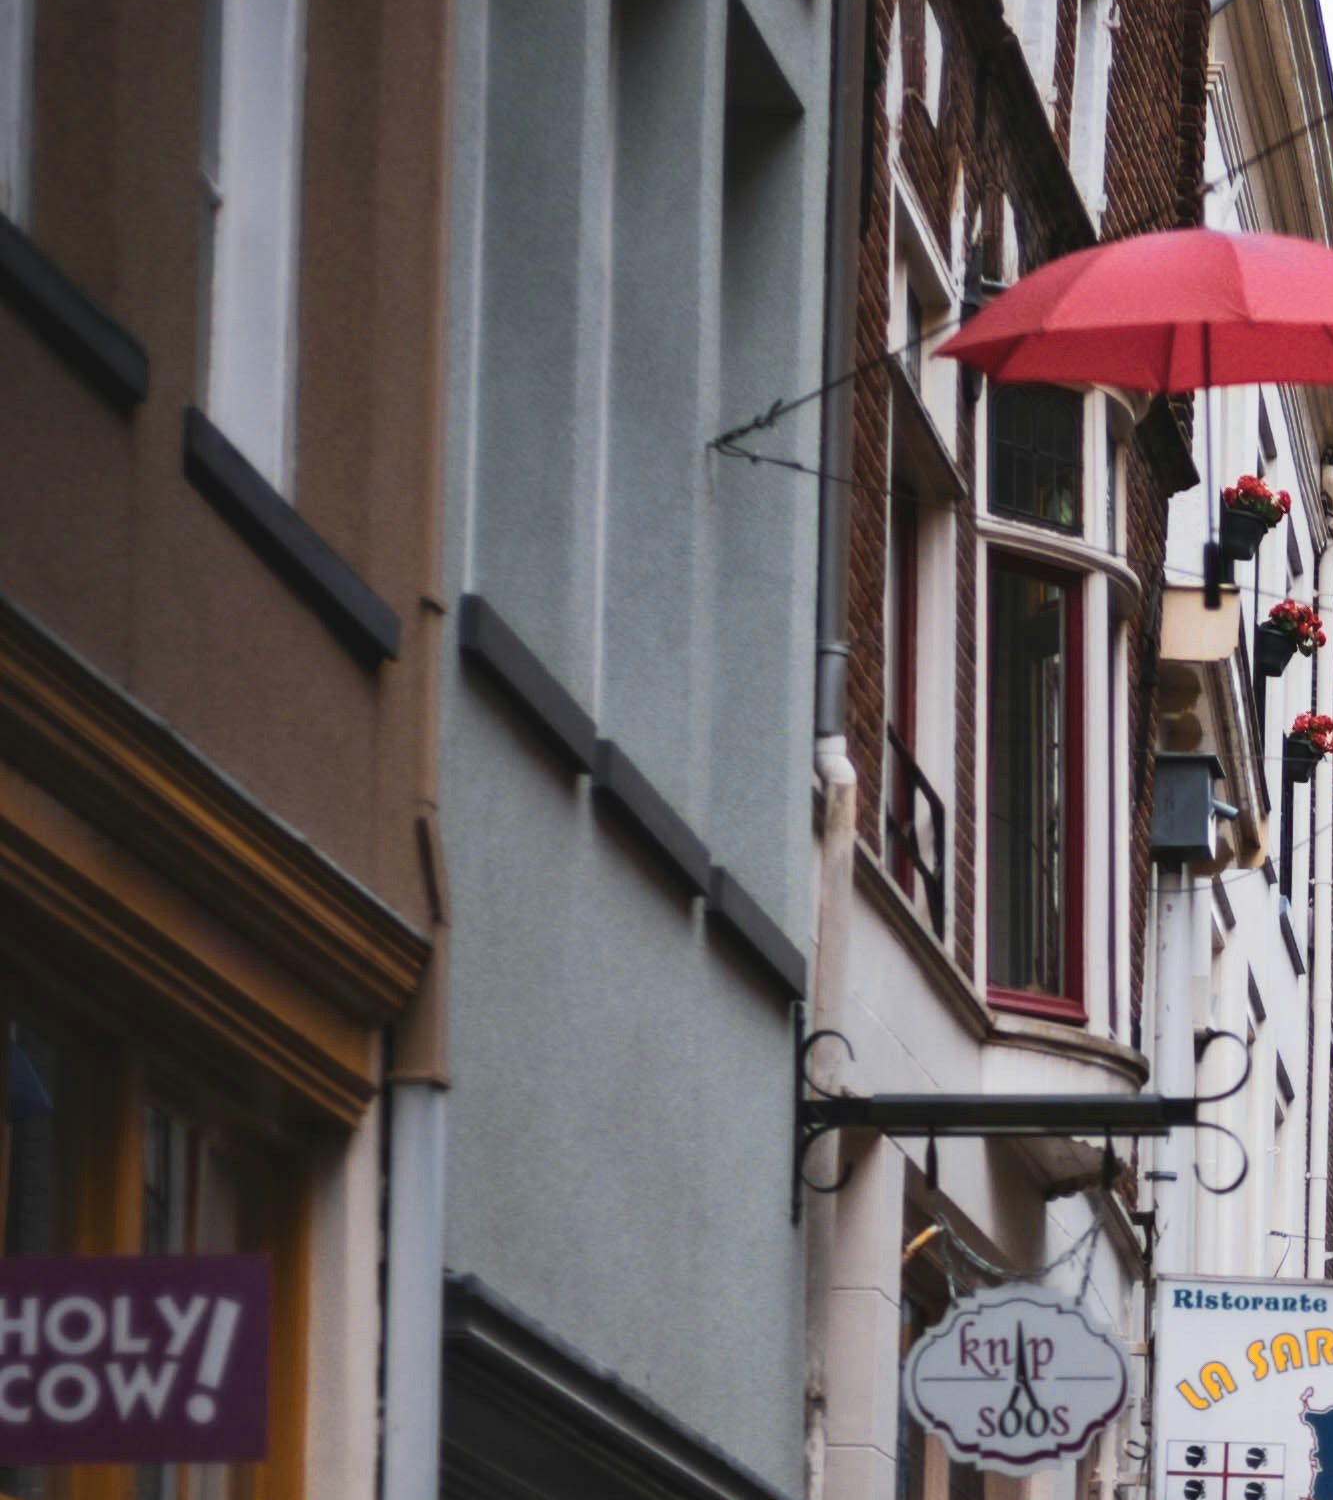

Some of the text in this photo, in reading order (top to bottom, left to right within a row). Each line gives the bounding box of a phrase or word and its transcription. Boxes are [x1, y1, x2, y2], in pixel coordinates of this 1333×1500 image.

[0, 1294, 209, 1357] HOLY
[1173, 1288, 1328, 1313] Ristorante
[1175, 1360, 1239, 1411] LA
